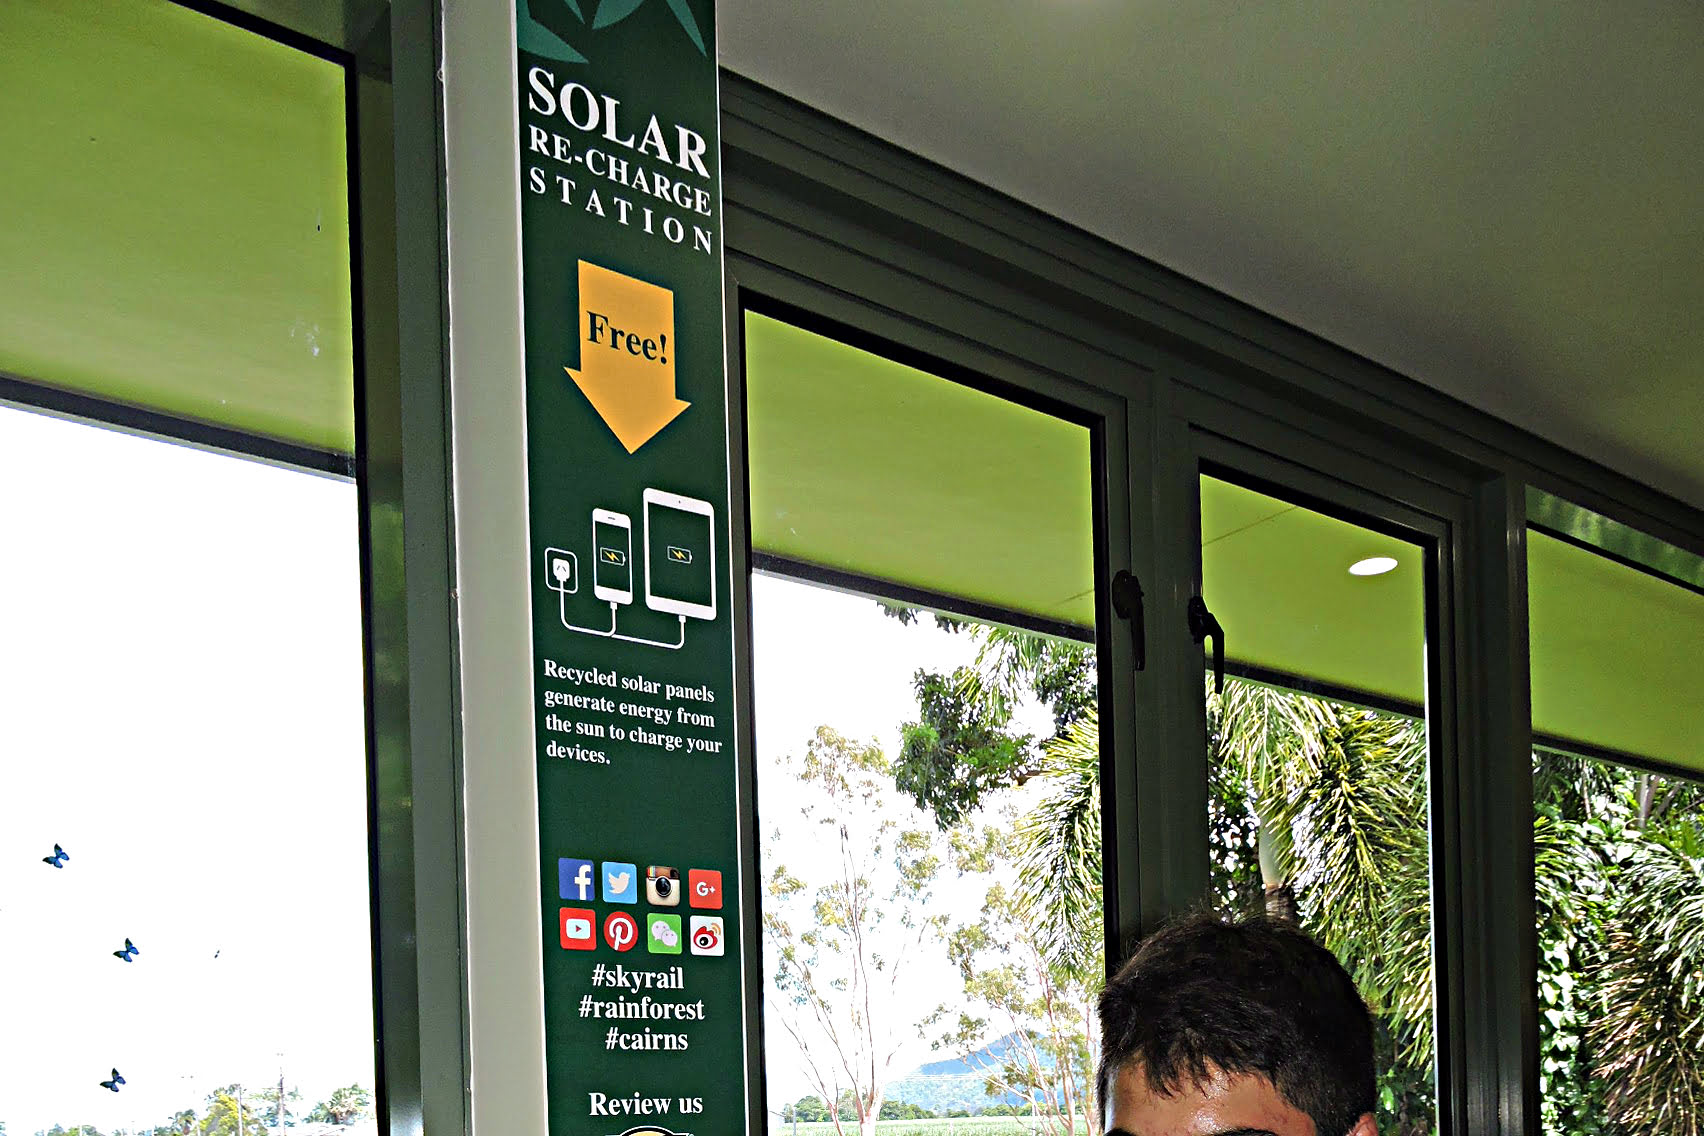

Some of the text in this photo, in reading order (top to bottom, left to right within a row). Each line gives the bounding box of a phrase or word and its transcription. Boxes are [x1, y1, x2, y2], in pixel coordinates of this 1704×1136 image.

[529, 67, 711, 179] SOLAR
[528, 125, 712, 216] RE-CHARGE
[530, 167, 712, 255] STATION
[586, 310, 667, 365] Free!
[544, 659, 715, 703] Recycled solar panels
[544, 690, 715, 727] generate energy from
[545, 714, 723, 753] the sun to charge your
[546, 740, 611, 765] devices.
[592, 963, 685, 994] #skyrail
[579, 995, 705, 1020] #rainforest
[605, 1027, 688, 1050] #cairns
[588, 1091, 703, 1116] Review us
